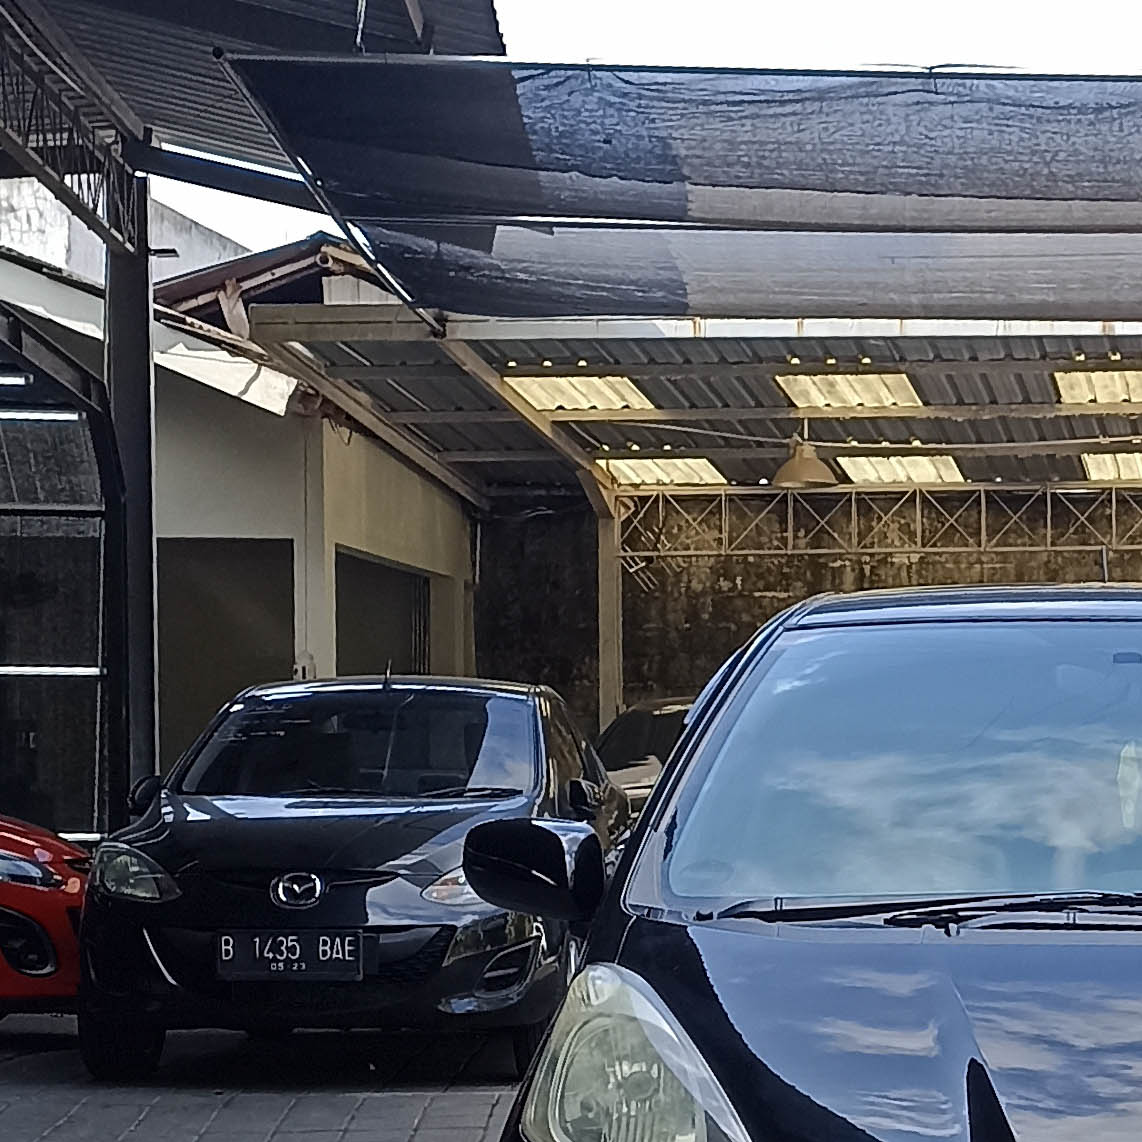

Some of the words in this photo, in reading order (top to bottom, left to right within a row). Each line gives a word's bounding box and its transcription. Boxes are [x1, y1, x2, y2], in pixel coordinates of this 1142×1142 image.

[221, 935, 234, 961] B
[253, 936, 300, 961] 1435
[318, 936, 356, 961] BAE
